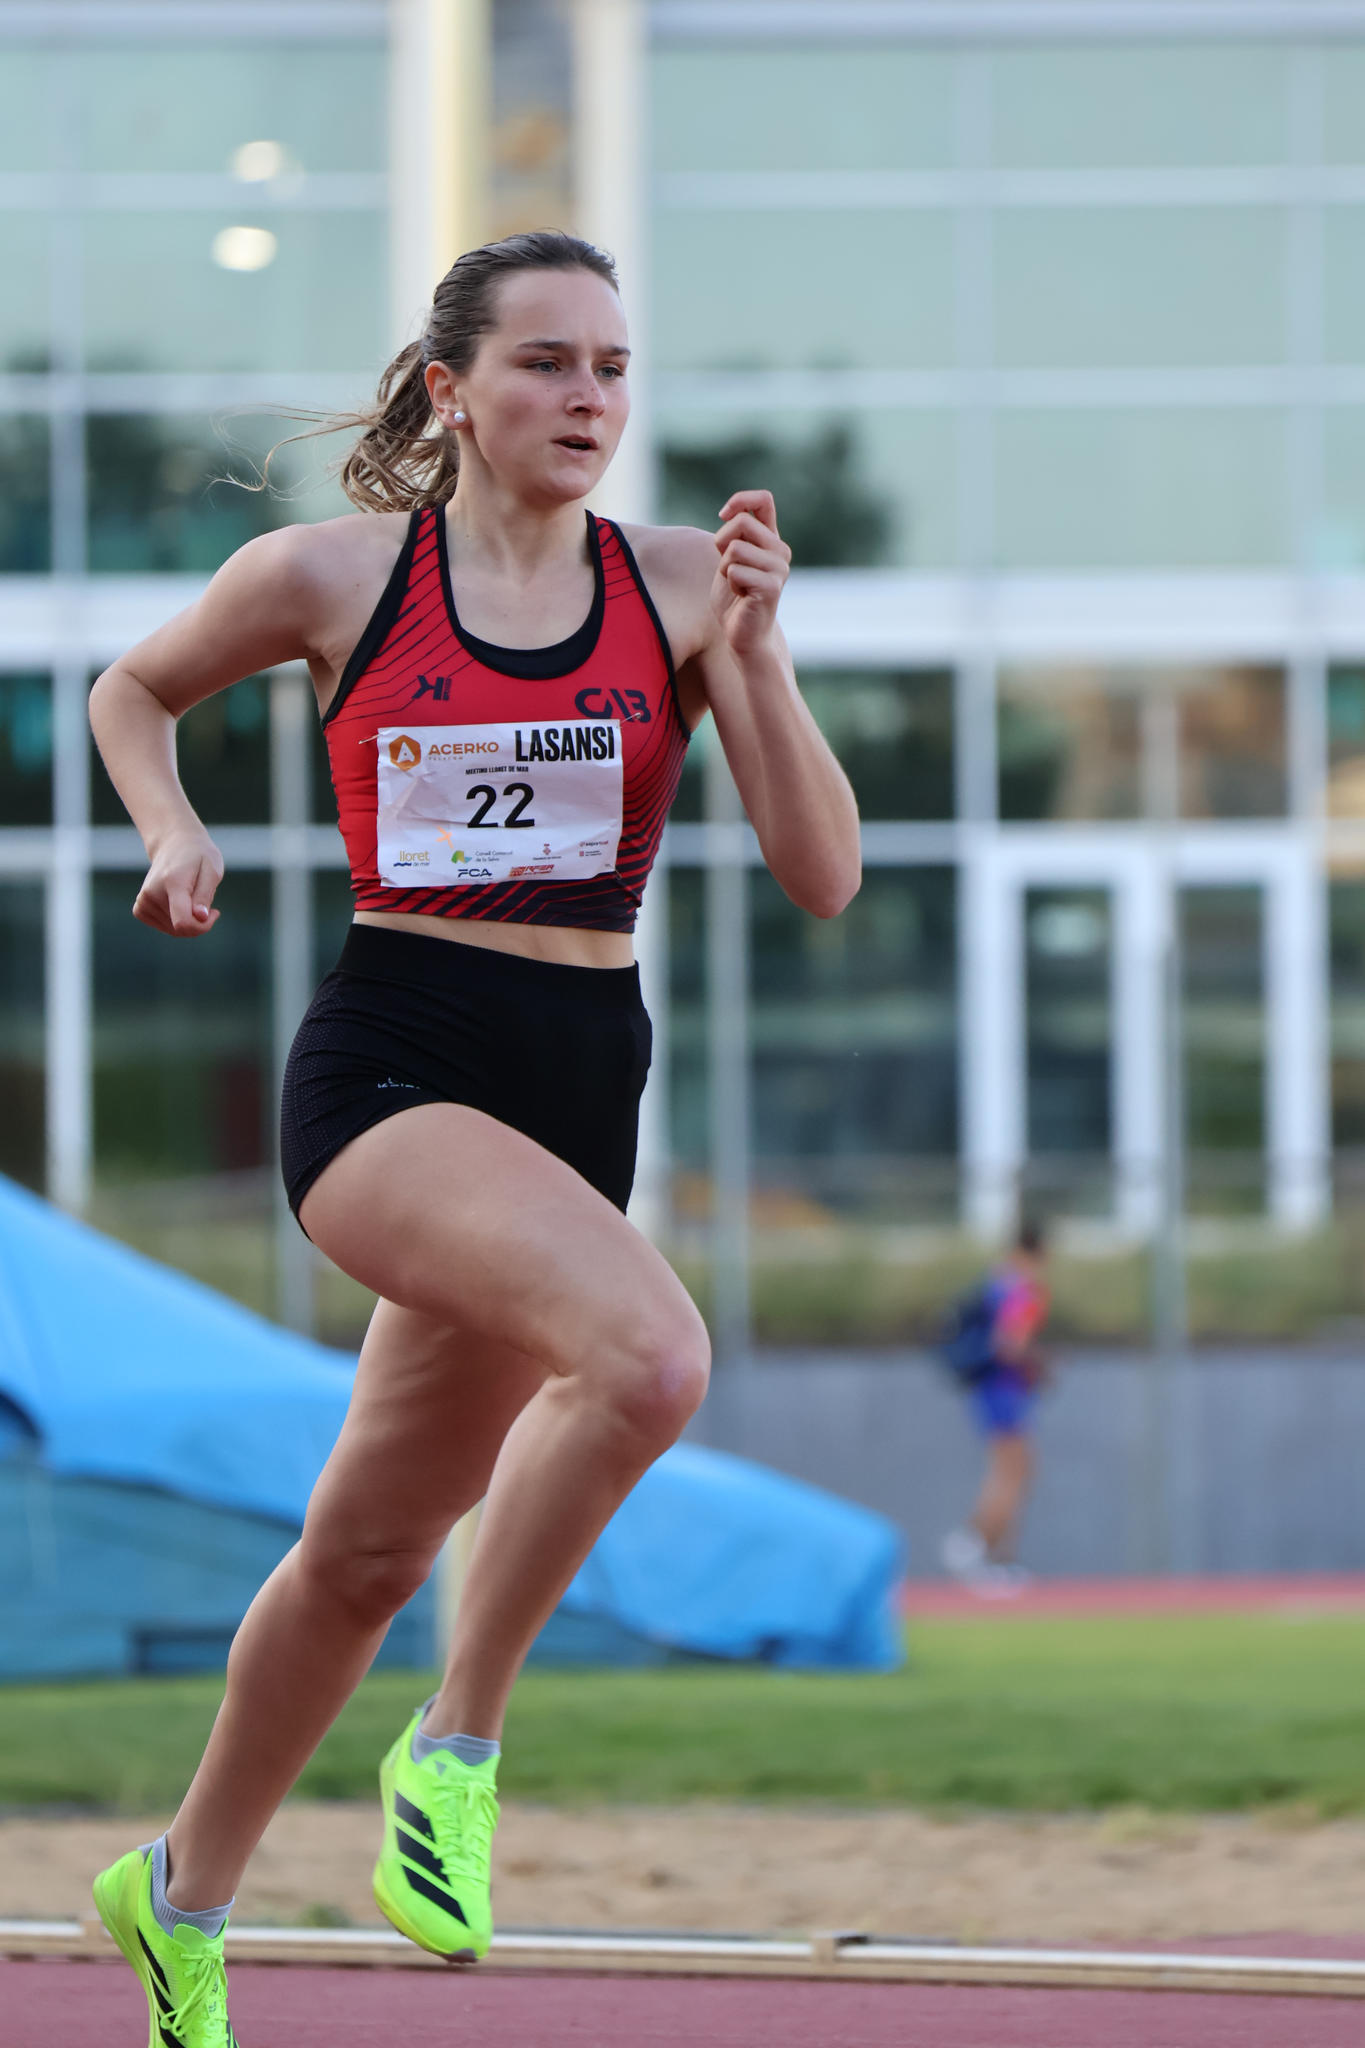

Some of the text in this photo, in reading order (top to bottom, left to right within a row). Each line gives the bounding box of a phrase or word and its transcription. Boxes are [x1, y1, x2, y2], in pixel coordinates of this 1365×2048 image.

[428, 742, 499, 755] ACERKO
[515, 726, 615, 762] LASANSI
[466, 782, 535, 828] 22
[400, 850, 430, 862] lloret
[457, 868, 493, 877] FCA
